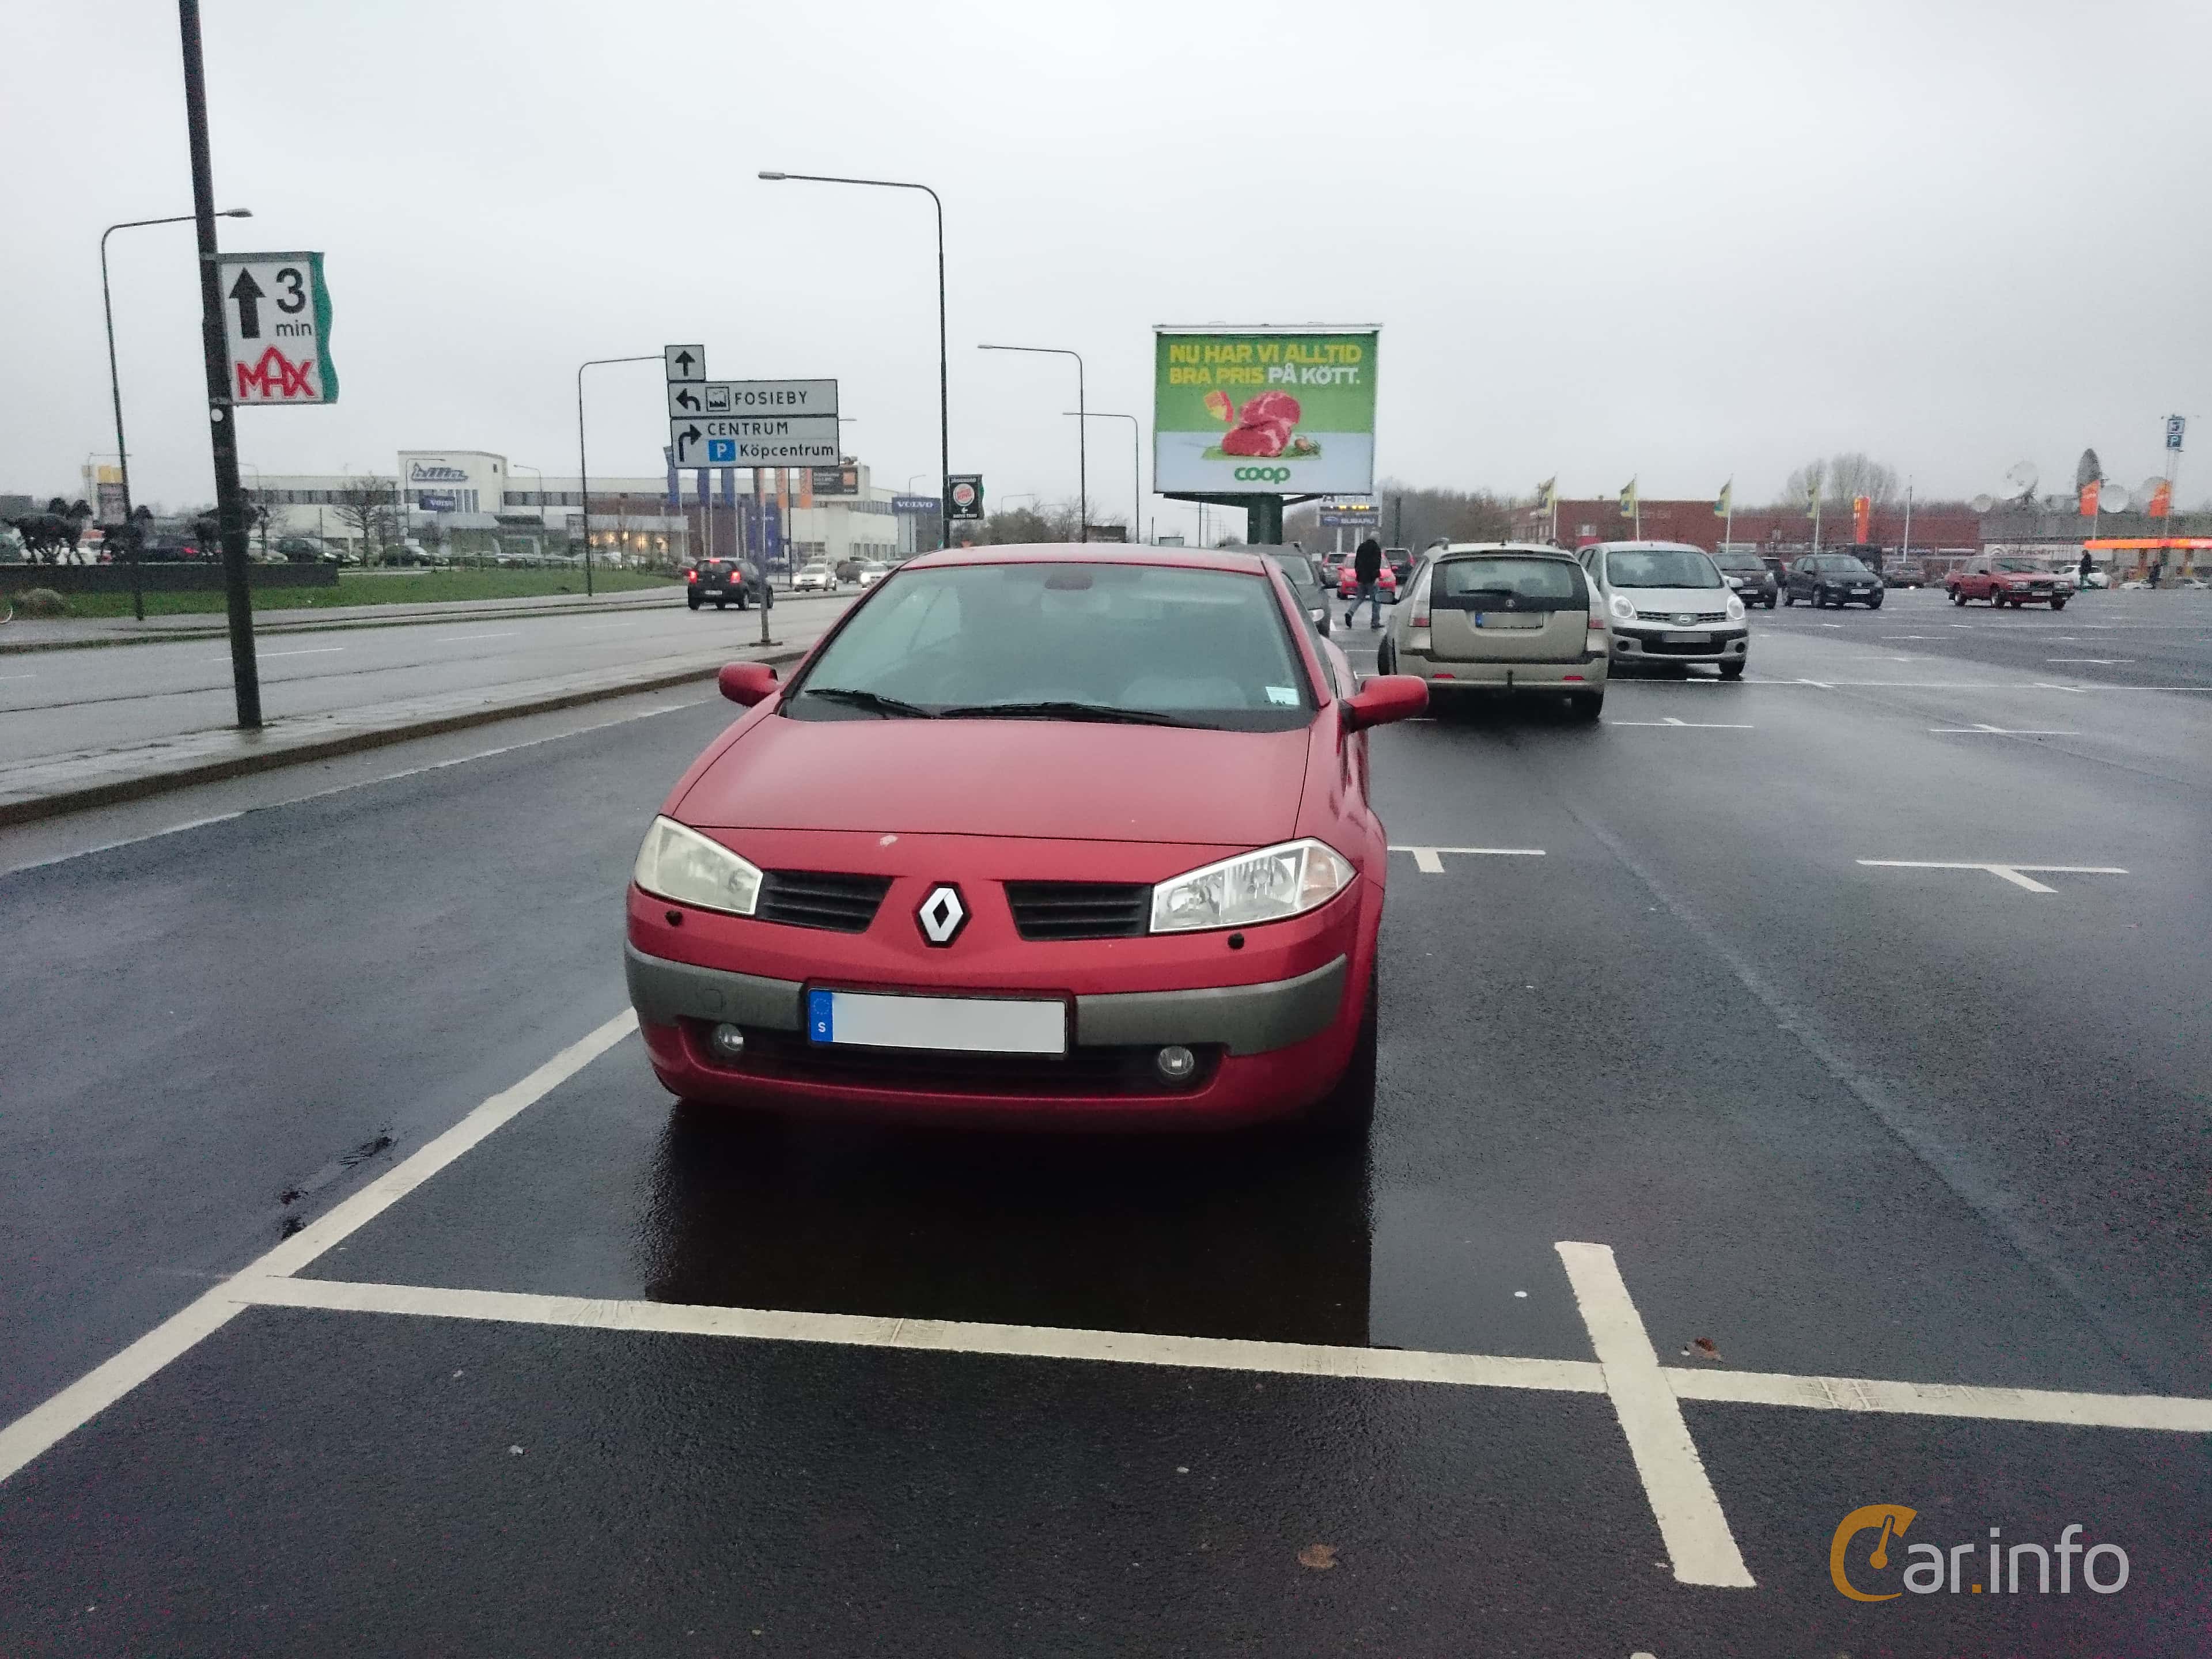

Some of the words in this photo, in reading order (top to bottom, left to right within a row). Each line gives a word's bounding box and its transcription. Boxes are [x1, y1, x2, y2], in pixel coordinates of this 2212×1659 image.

[276, 267, 306, 315] 3
[275, 319, 312, 337] min
[1170, 344, 1200, 363] NU
[1204, 344, 1252, 363] HAR
[1257, 344, 1279, 363] VI
[1284, 344, 1362, 363] ALLTID
[236, 344, 318, 399] MAX
[1170, 367, 1210, 384] BRA
[1217, 367, 1263, 384] PRIS
[1268, 362, 1297, 384] PÅ
[1301, 365, 1361, 385] KÖTT.
[734, 391, 808, 405] FOSIEBY
[707, 422, 789, 435] CENTRUM
[716, 444, 728, 459] P
[740, 444, 834, 459] Köpcentrum
[1234, 467, 1291, 484] coop
[818, 1022, 826, 1033] S
